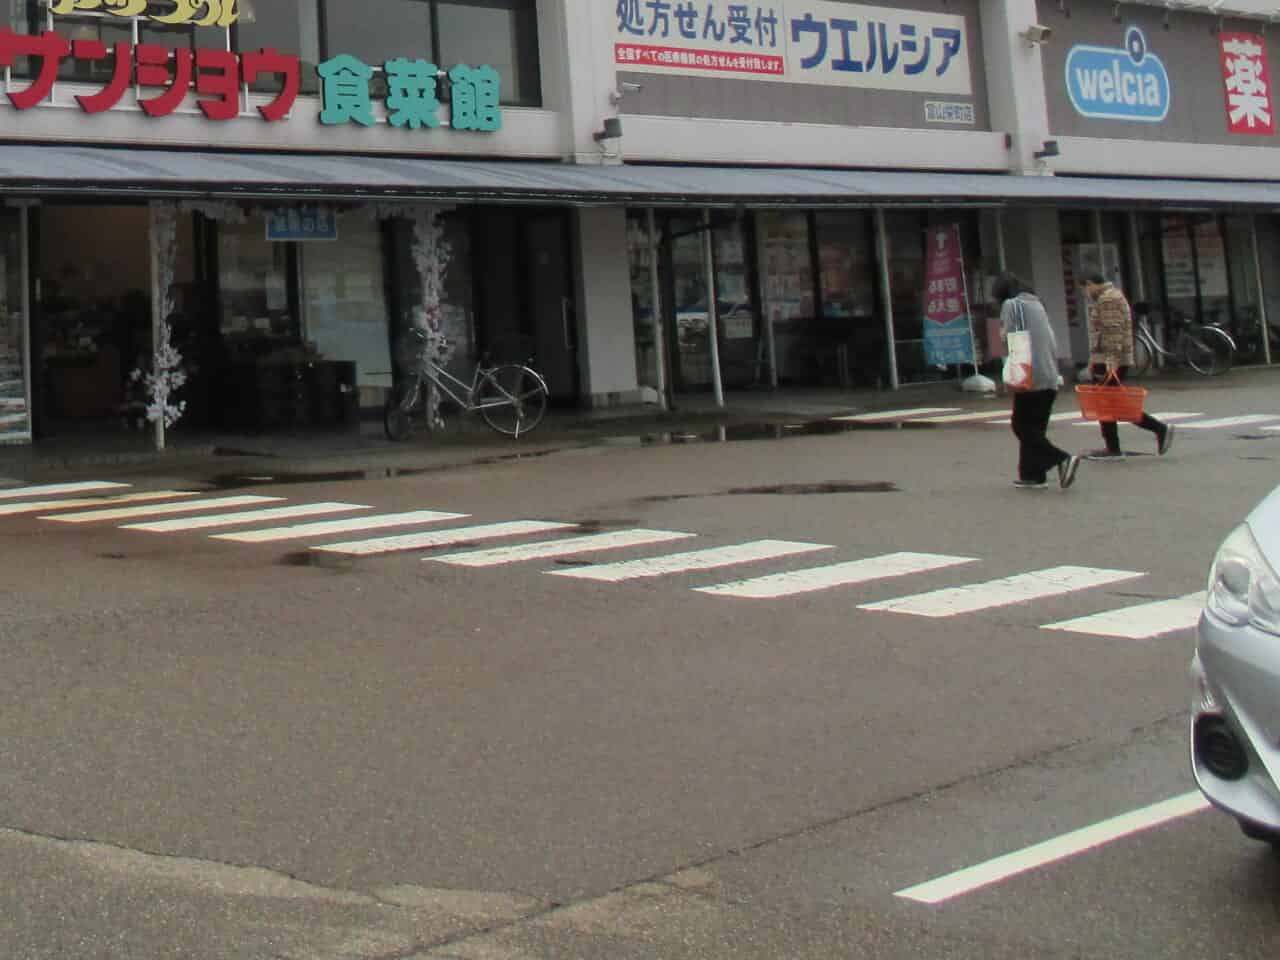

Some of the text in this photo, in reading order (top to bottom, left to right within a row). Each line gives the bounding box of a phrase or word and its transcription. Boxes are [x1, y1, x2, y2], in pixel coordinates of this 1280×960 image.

[790, 12, 962, 77] ウエルシア
[318, 53, 503, 132] 食菜館
[1075, 58, 1161, 108] welcia
[1222, 37, 1272, 128] 薬
